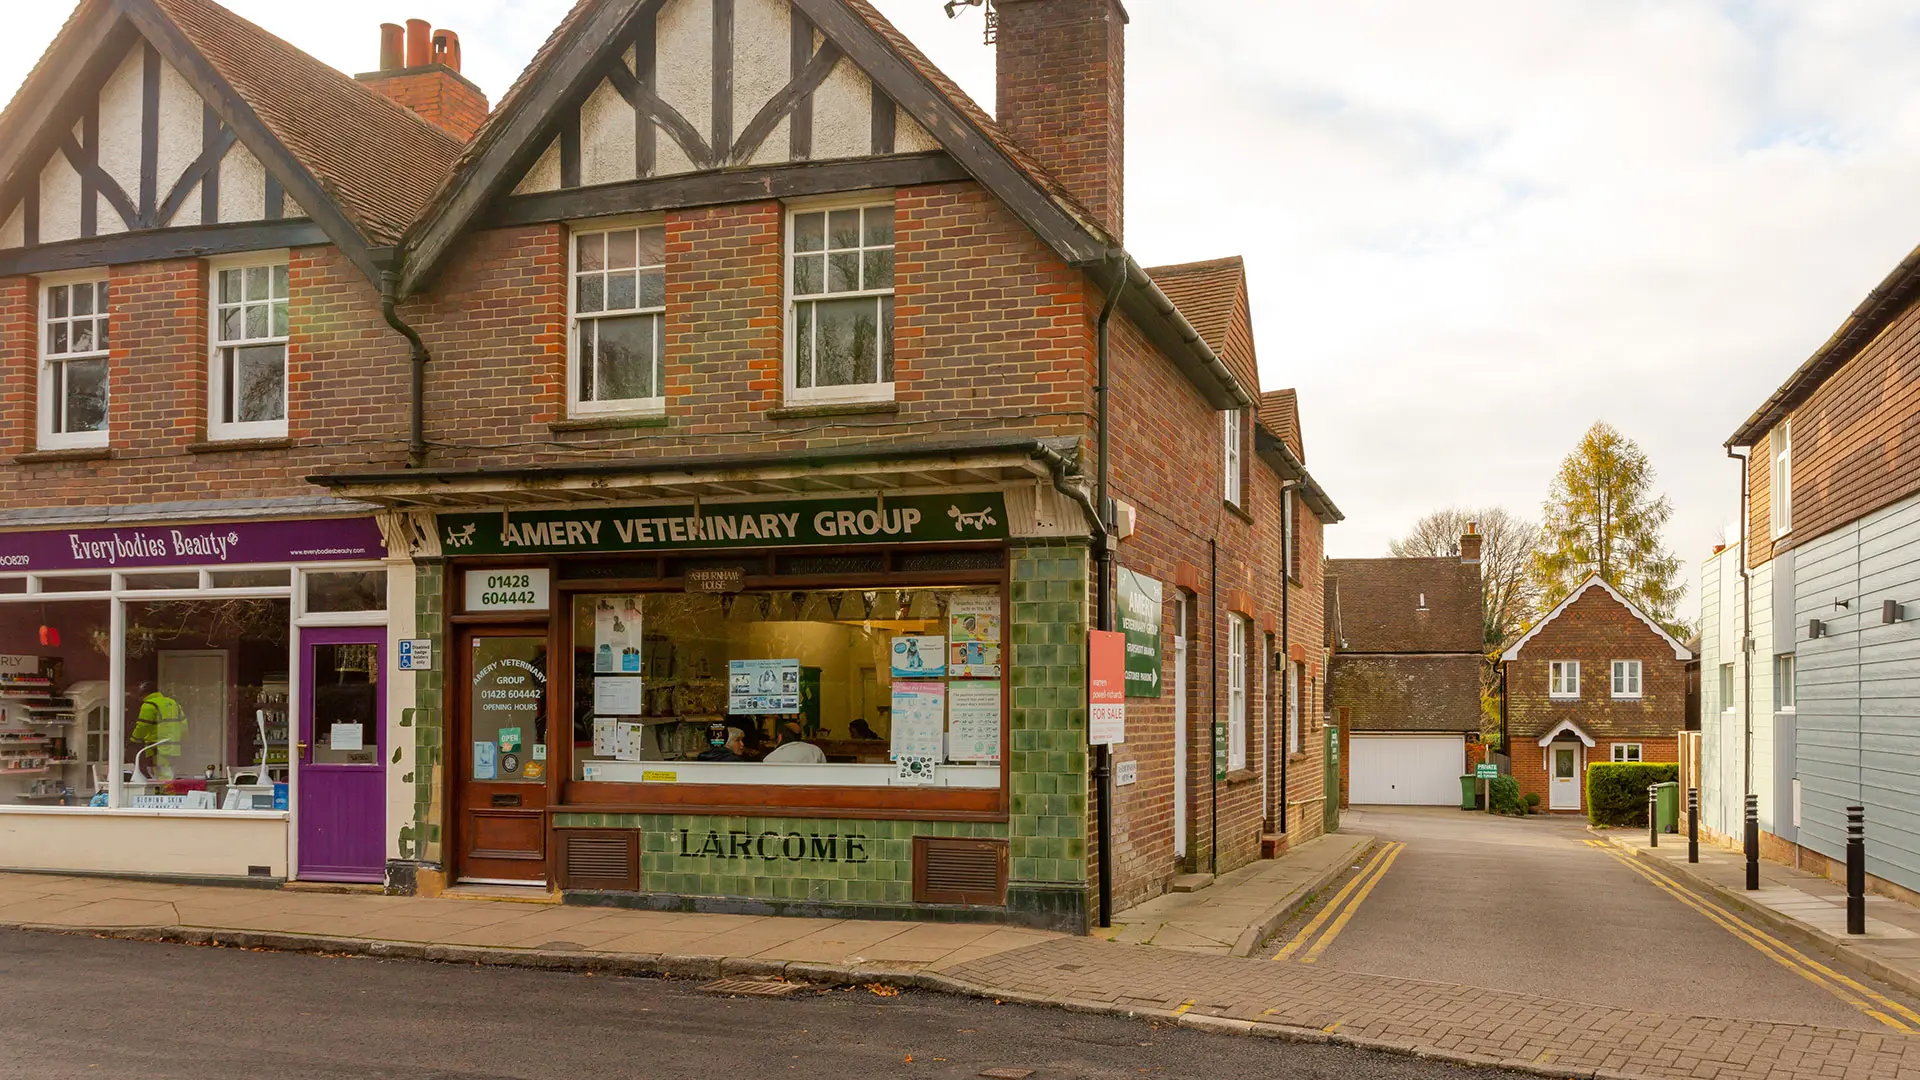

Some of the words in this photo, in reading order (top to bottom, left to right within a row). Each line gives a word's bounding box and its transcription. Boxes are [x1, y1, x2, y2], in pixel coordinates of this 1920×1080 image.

[502, 520, 602, 547] AMERY
[613, 512, 800, 544] VETERINARY
[813, 508, 922, 537] GROUP
[69, 533, 167, 564] Everybodies
[170, 530, 228, 560] Beauty
[487, 575, 530, 588] 01428
[702, 580, 726, 590] HOUSE
[481, 591, 536, 605] 604442
[473, 661, 498, 685] AMERY
[500, 658, 547, 683] VETERINARY
[496, 676, 525, 685] GROUP
[481, 690, 506, 699] 01428
[508, 689, 541, 699] 604442
[514, 703, 538, 711] HOURS
[1092, 708, 1106, 720] FOR
[1107, 708, 1122, 720] SALE
[501, 734, 519, 742] OPEN
[679, 828, 869, 863] LARCOME
